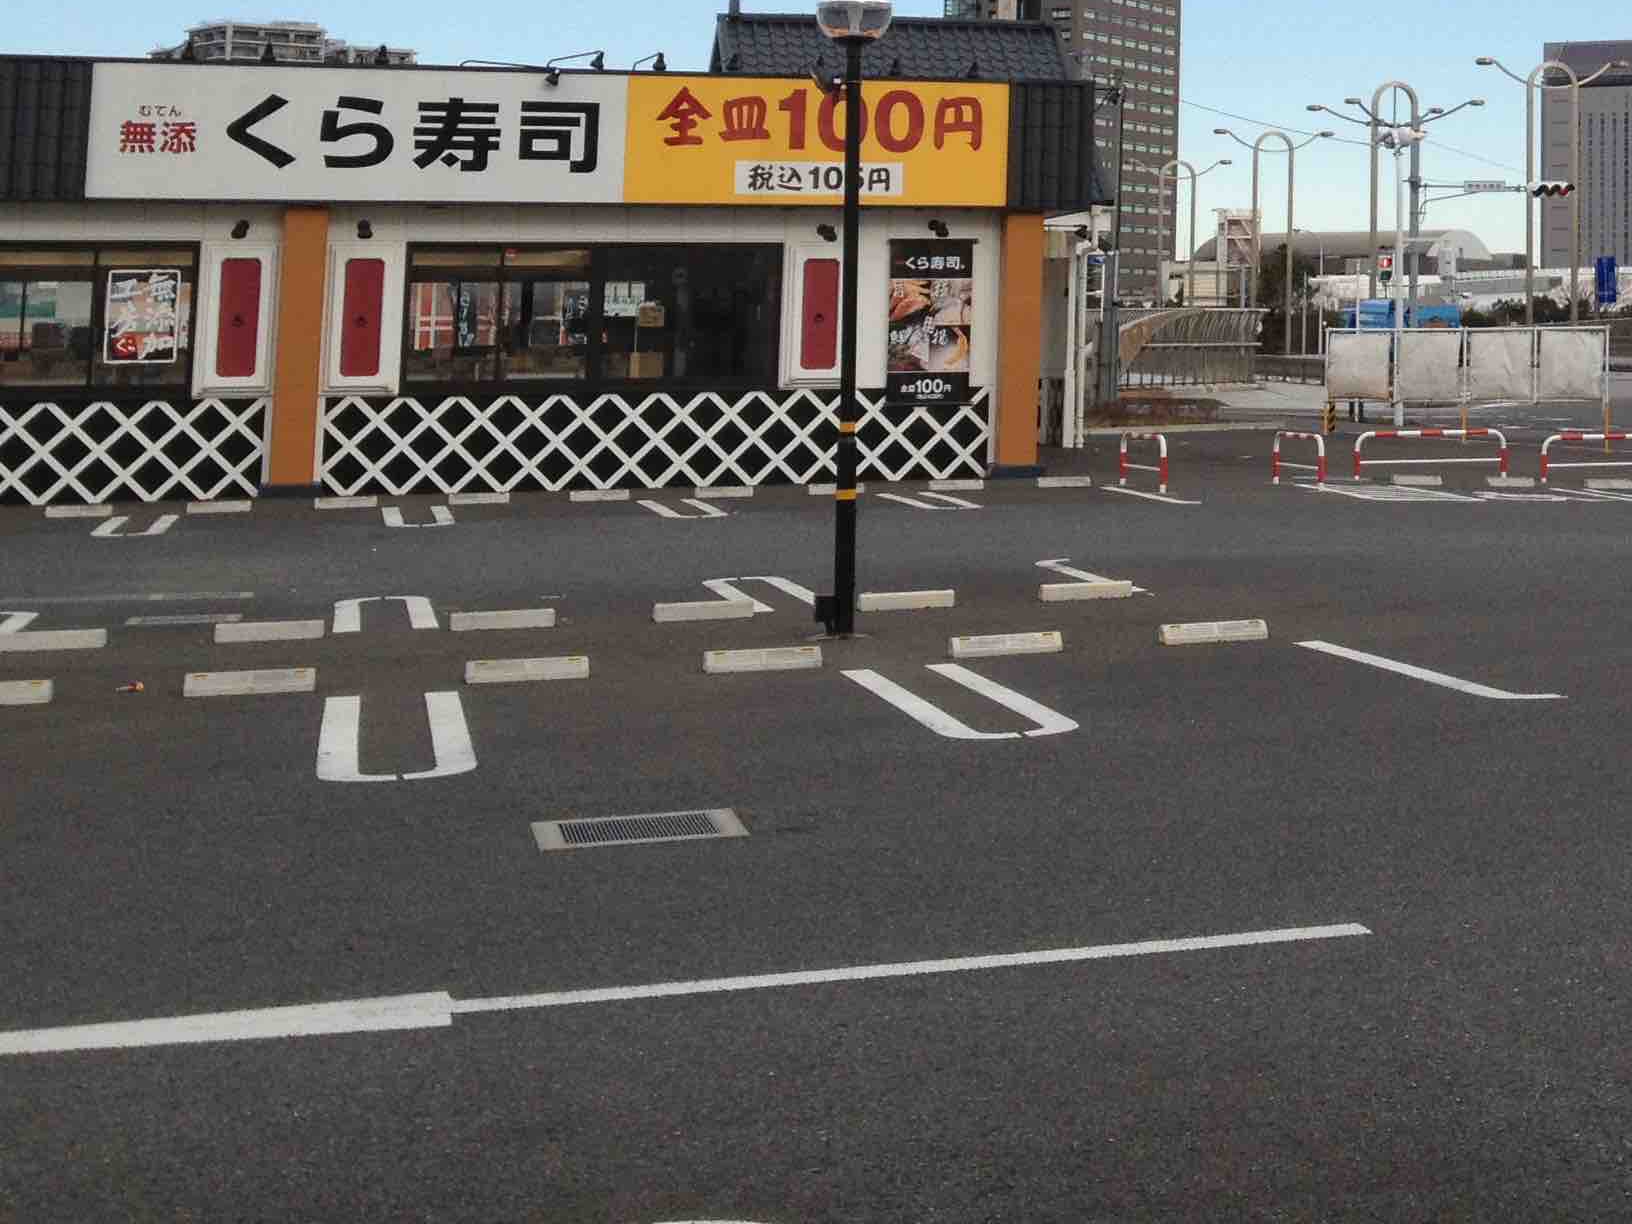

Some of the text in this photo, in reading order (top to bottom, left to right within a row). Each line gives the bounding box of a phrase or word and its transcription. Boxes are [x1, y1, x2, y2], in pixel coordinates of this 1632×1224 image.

[138, 104, 182, 118] むてん
[119, 120, 197, 154] 無添
[226, 93, 600, 173] くら寿司
